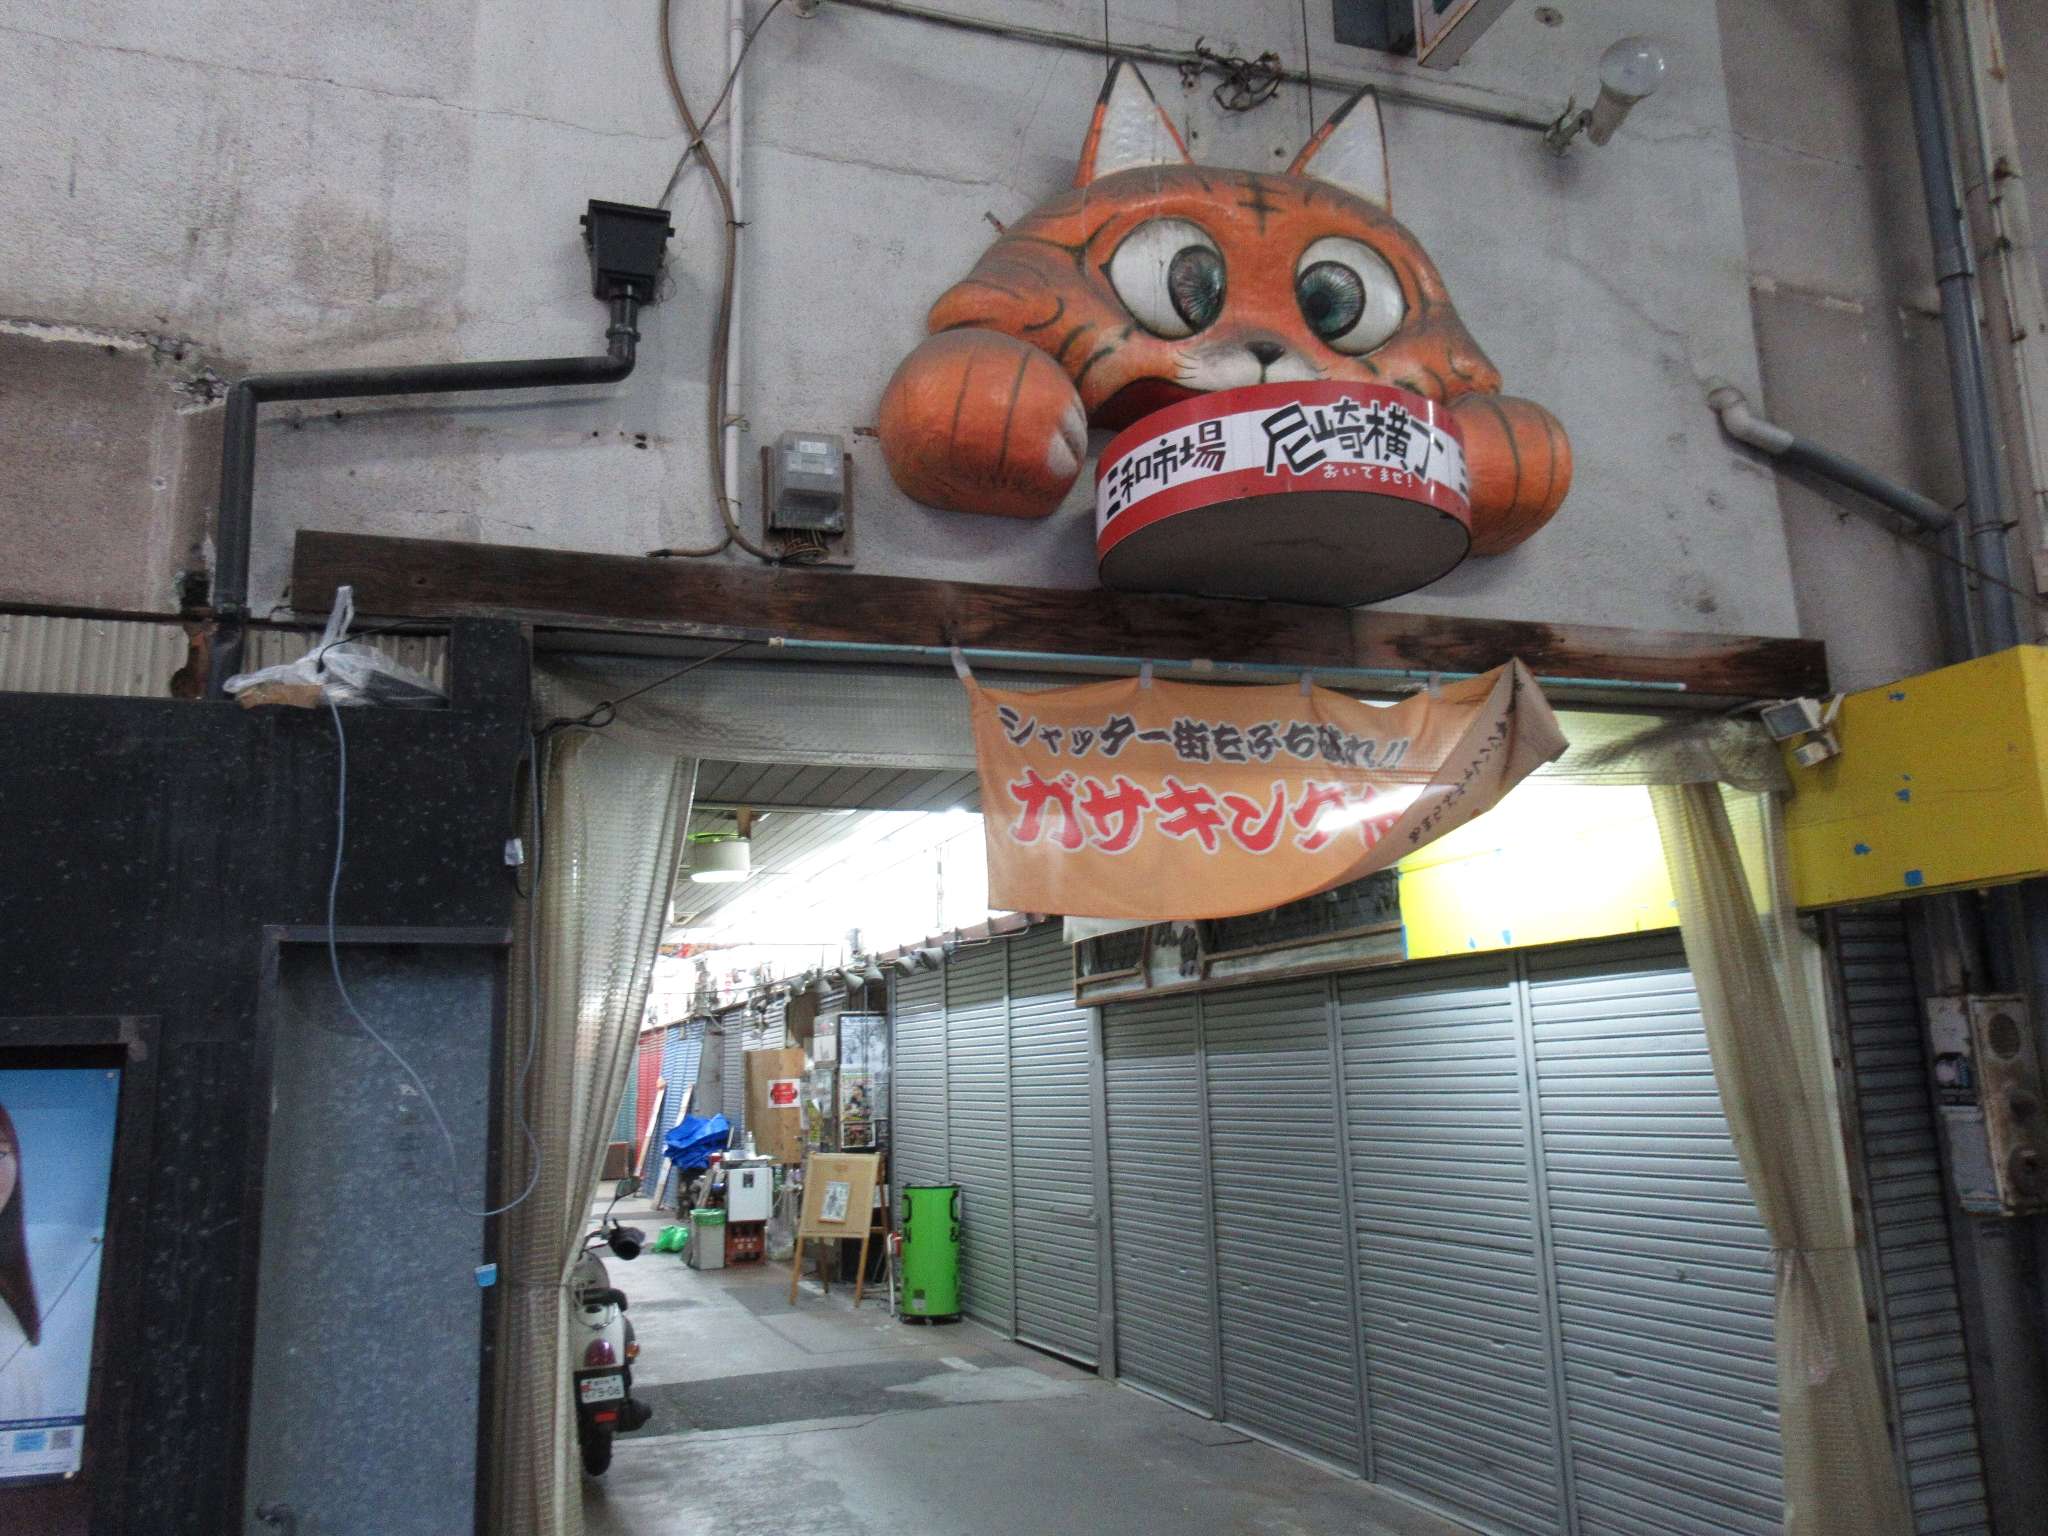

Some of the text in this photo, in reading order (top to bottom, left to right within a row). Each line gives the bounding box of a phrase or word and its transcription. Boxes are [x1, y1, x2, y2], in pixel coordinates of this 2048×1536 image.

[1106, 421, 1227, 520] 三和市場
[1260, 397, 1446, 480] 尼崎横丁
